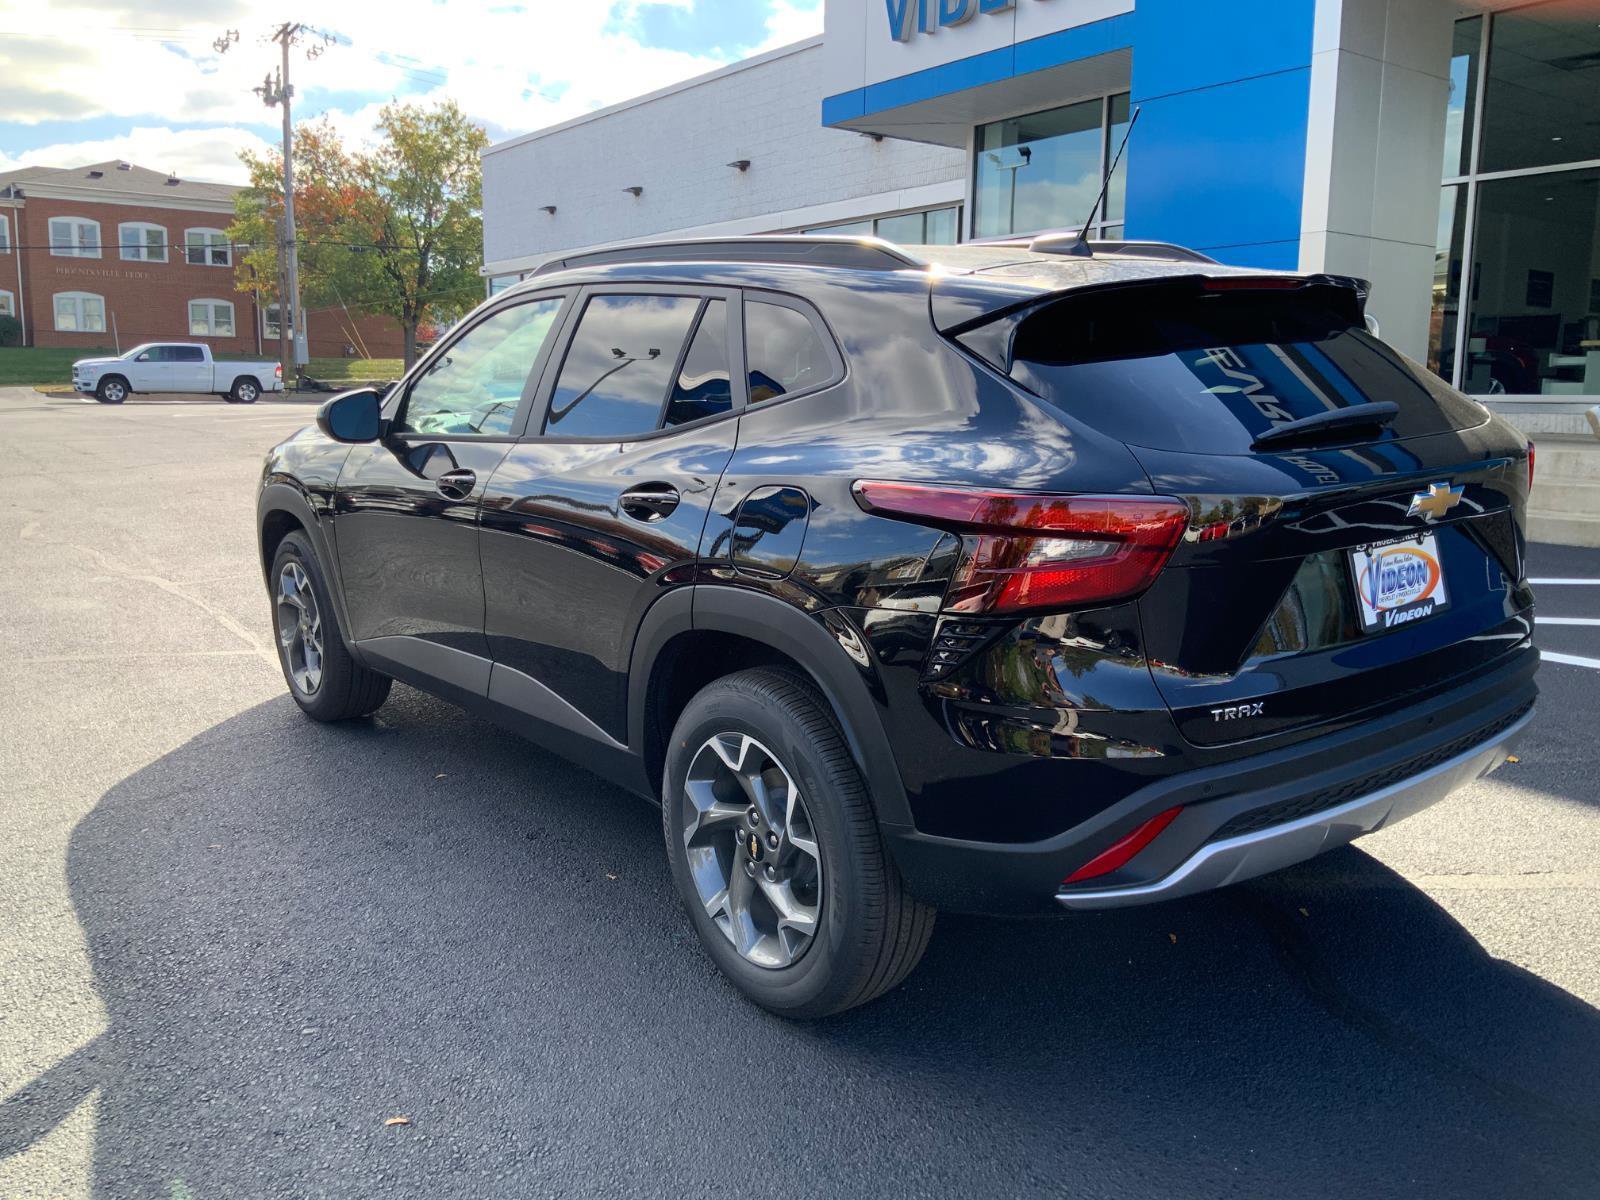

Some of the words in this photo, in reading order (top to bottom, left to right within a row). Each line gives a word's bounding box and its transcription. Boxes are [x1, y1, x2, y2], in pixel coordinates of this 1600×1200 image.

[1366, 553, 1429, 612] VIDEON
[1384, 604, 1433, 628] VIDEON
[1210, 701, 1264, 722] TRAX
